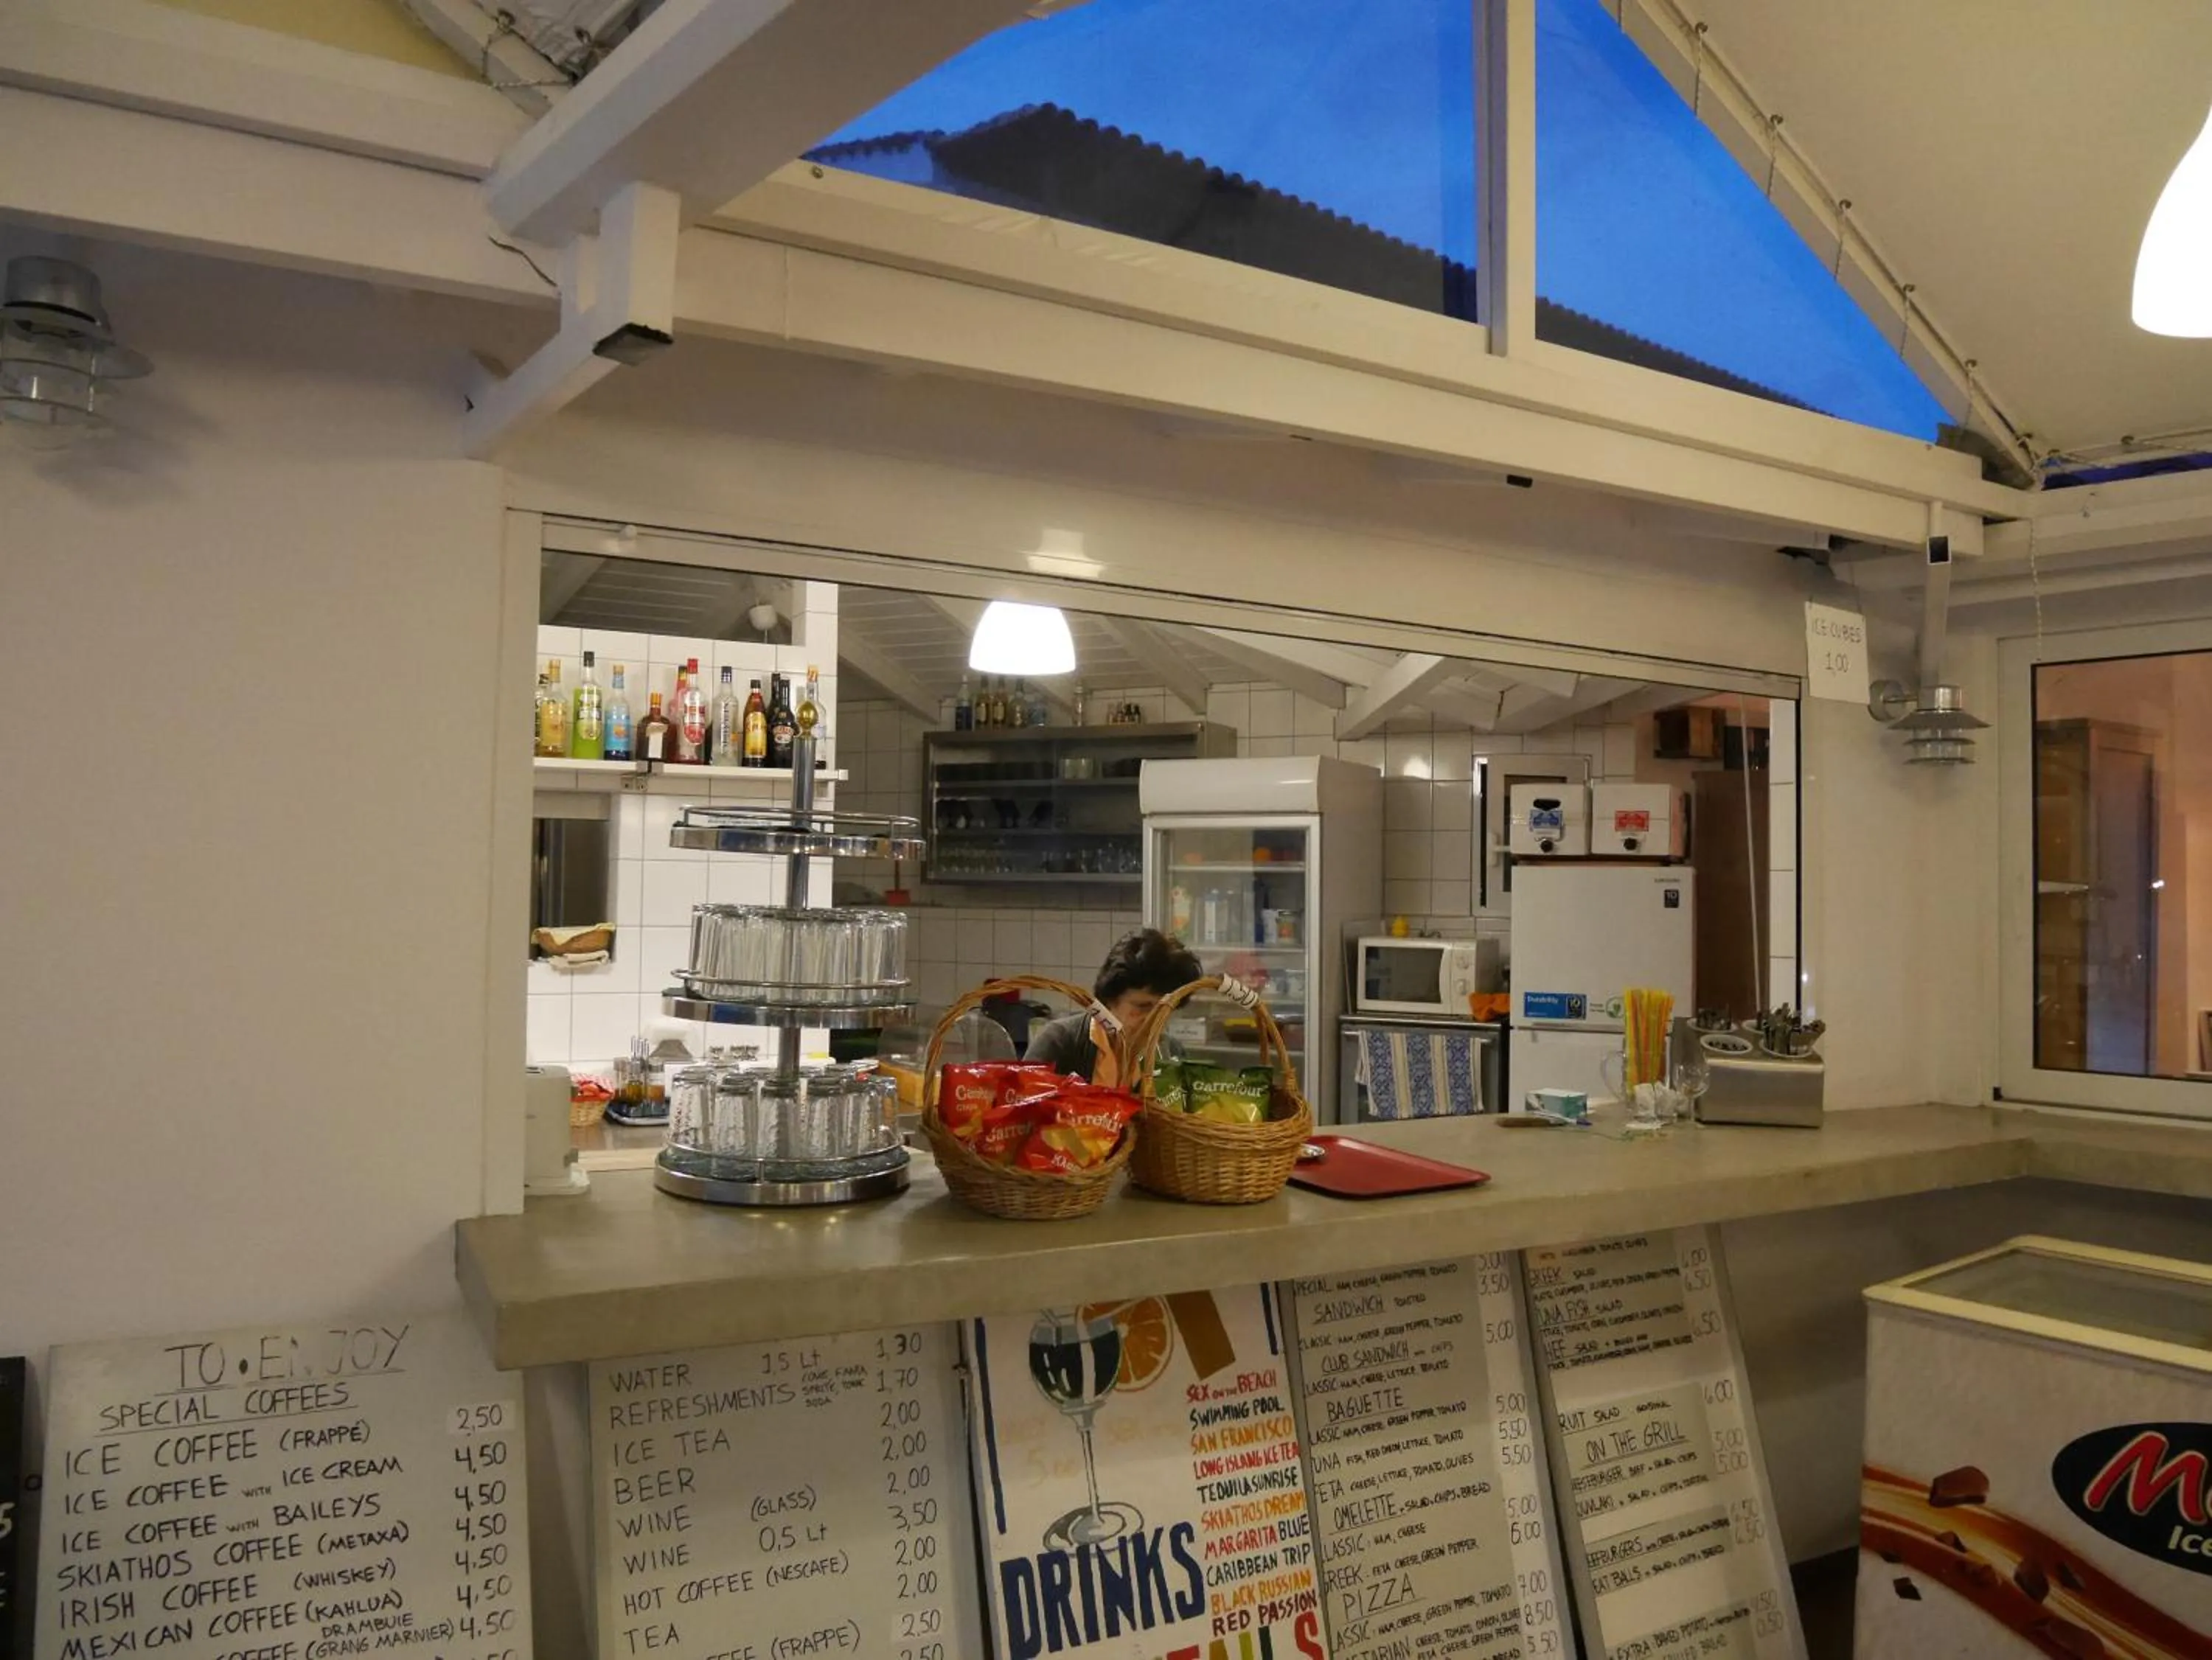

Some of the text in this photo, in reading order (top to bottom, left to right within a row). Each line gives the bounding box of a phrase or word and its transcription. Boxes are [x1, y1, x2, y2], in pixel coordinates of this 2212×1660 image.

[1192, 1081, 1263, 1098] Carrefour
[1314, 1294, 1383, 1322] SANDWICH
[164, 1342, 225, 1387] TO
[608, 1364, 692, 1393] WATER
[1186, 1384, 1209, 1402] SEX
[1237, 1369, 1276, 1394] BEACH
[1305, 1377, 1338, 1395] LASSIC
[100, 1382, 349, 1431] SPECIAL COFFEES
[610, 1382, 796, 1430] REFRESHMENTS
[1190, 1396, 1285, 1431] SWIMMING POOL
[1327, 1387, 1404, 1423] BAGUETTE
[1558, 1411, 1586, 1432] RUIT
[66, 1443, 120, 1479] ICE
[154, 1429, 257, 1467] COFFEE
[613, 1438, 655, 1467] ICE
[675, 1429, 731, 1457] TEA
[1191, 1415, 1293, 1455] SAN FRANCISCO
[1310, 1427, 1340, 1445] LASSIC
[1610, 1429, 1637, 1456] THE
[1644, 1420, 1686, 1448] GRILL
[1193, 1457, 1223, 1479] LONG
[1264, 1445, 1279, 1466] ICE
[1253, 1466, 1298, 1493] SUNRISE
[2083, 1431, 2212, 1525] M
[66, 1490, 108, 1514] ICE
[127, 1474, 229, 1507] COFFEE
[283, 1468, 314, 1486] ICE
[321, 1456, 403, 1480] CREAM
[613, 1467, 696, 1504] BEER
[63, 1531, 100, 1554] ICE
[125, 1514, 217, 1544] COFFEE
[273, 1493, 381, 1527] BAILEYS
[616, 1504, 692, 1538] WINE
[751, 1485, 818, 1522] (GLASS)
[1201, 1502, 1264, 1533] SKIATHOS
[1333, 1492, 1398, 1530] OMELETTE
[58, 1550, 192, 1591] SKIATHOS
[213, 1534, 302, 1566] COFFEE
[318, 1520, 409, 1555] (METAXA)
[1205, 1514, 1310, 1560] MARGARITA BLUE
[1323, 1532, 1366, 1563] LASSIC
[623, 1544, 690, 1576] WINE
[1206, 1543, 1310, 1587] CARIBBEAN TRIP
[60, 1591, 135, 1629] IRISH
[162, 1574, 258, 1611] COFFEE
[294, 1557, 396, 1591] (WHISKEY)
[623, 1587, 664, 1616] HOT
[677, 1571, 755, 1604] COFFEE
[766, 1551, 849, 1587] (NESCAFE)
[1000, 1521, 1206, 1660] DRINKS
[1211, 1569, 1312, 1617] BLACK RUSSIAN
[1343, 1572, 1416, 1621] PIZZA
[60, 1618, 192, 1660] MEXICAN
[209, 1602, 298, 1637] COFFEE
[305, 1588, 403, 1622] (KAHLUA)
[321, 1613, 414, 1638] DRAMBUIE
[1212, 1609, 1251, 1637] RED
[1257, 1589, 1318, 1625] PASSION
[376, 1618, 454, 1647] MARNIER)
[623, 1623, 680, 1654] TEA
[771, 1619, 863, 1660] (FRAPPE)
